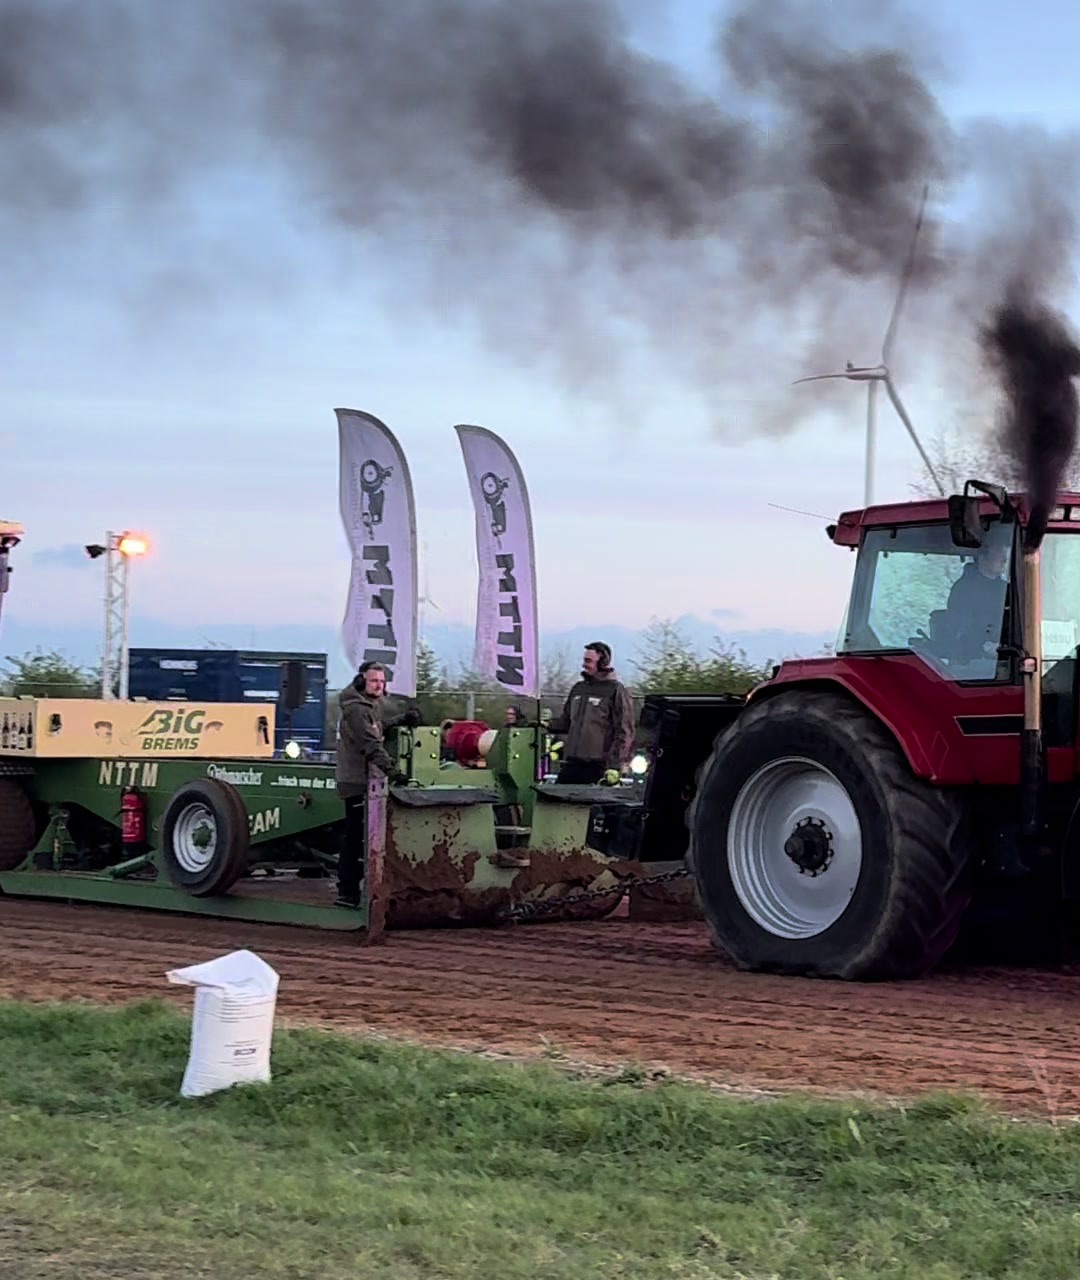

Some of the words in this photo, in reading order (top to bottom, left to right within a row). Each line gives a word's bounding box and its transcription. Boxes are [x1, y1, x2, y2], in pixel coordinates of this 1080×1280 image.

[142, 737, 200, 751] BREMS
[98, 761, 159, 787] NTTM
[248, 807, 281, 836] AM
